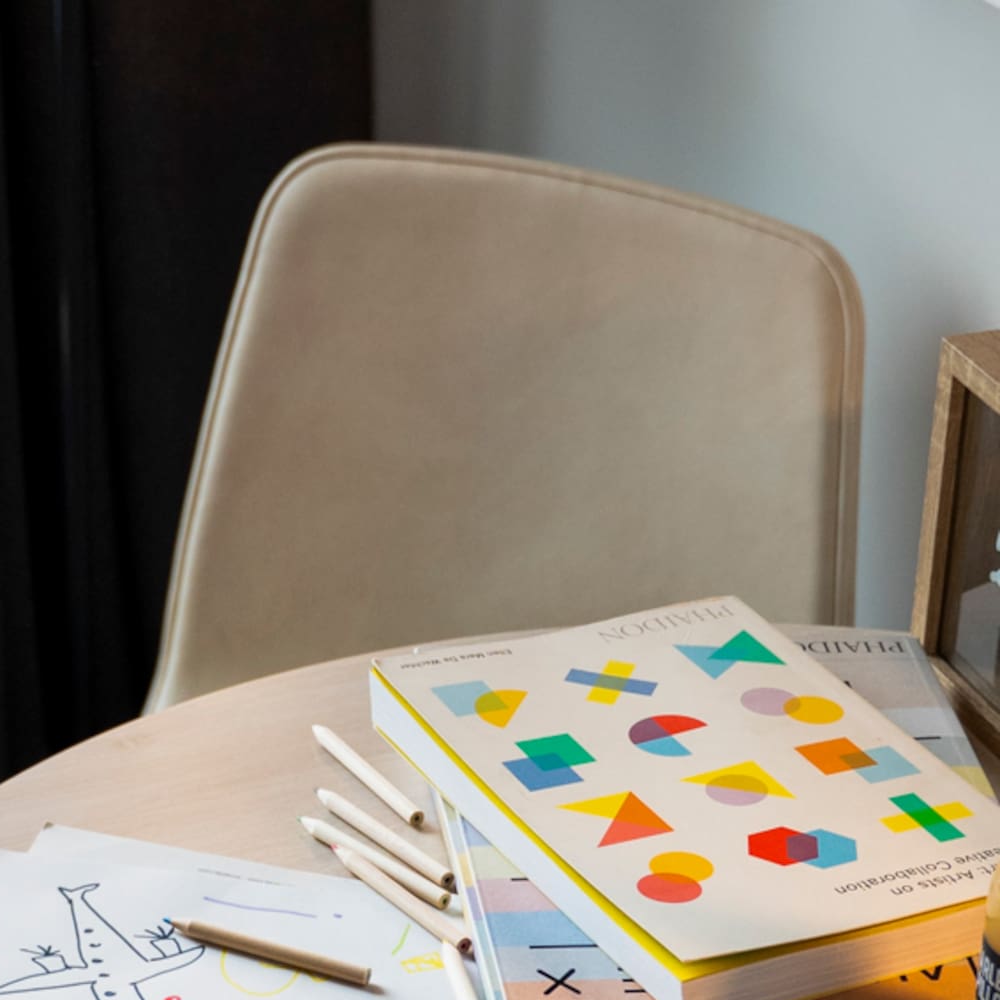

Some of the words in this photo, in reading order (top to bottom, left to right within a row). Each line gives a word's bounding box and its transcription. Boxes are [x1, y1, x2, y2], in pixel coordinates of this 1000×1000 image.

[599, 604, 735, 644] PHAIDON
[796, 639, 905, 654] PHAID
[833, 859, 953, 896] Collaboration
[917, 868, 975, 890] Artists
[889, 882, 915, 897] on
